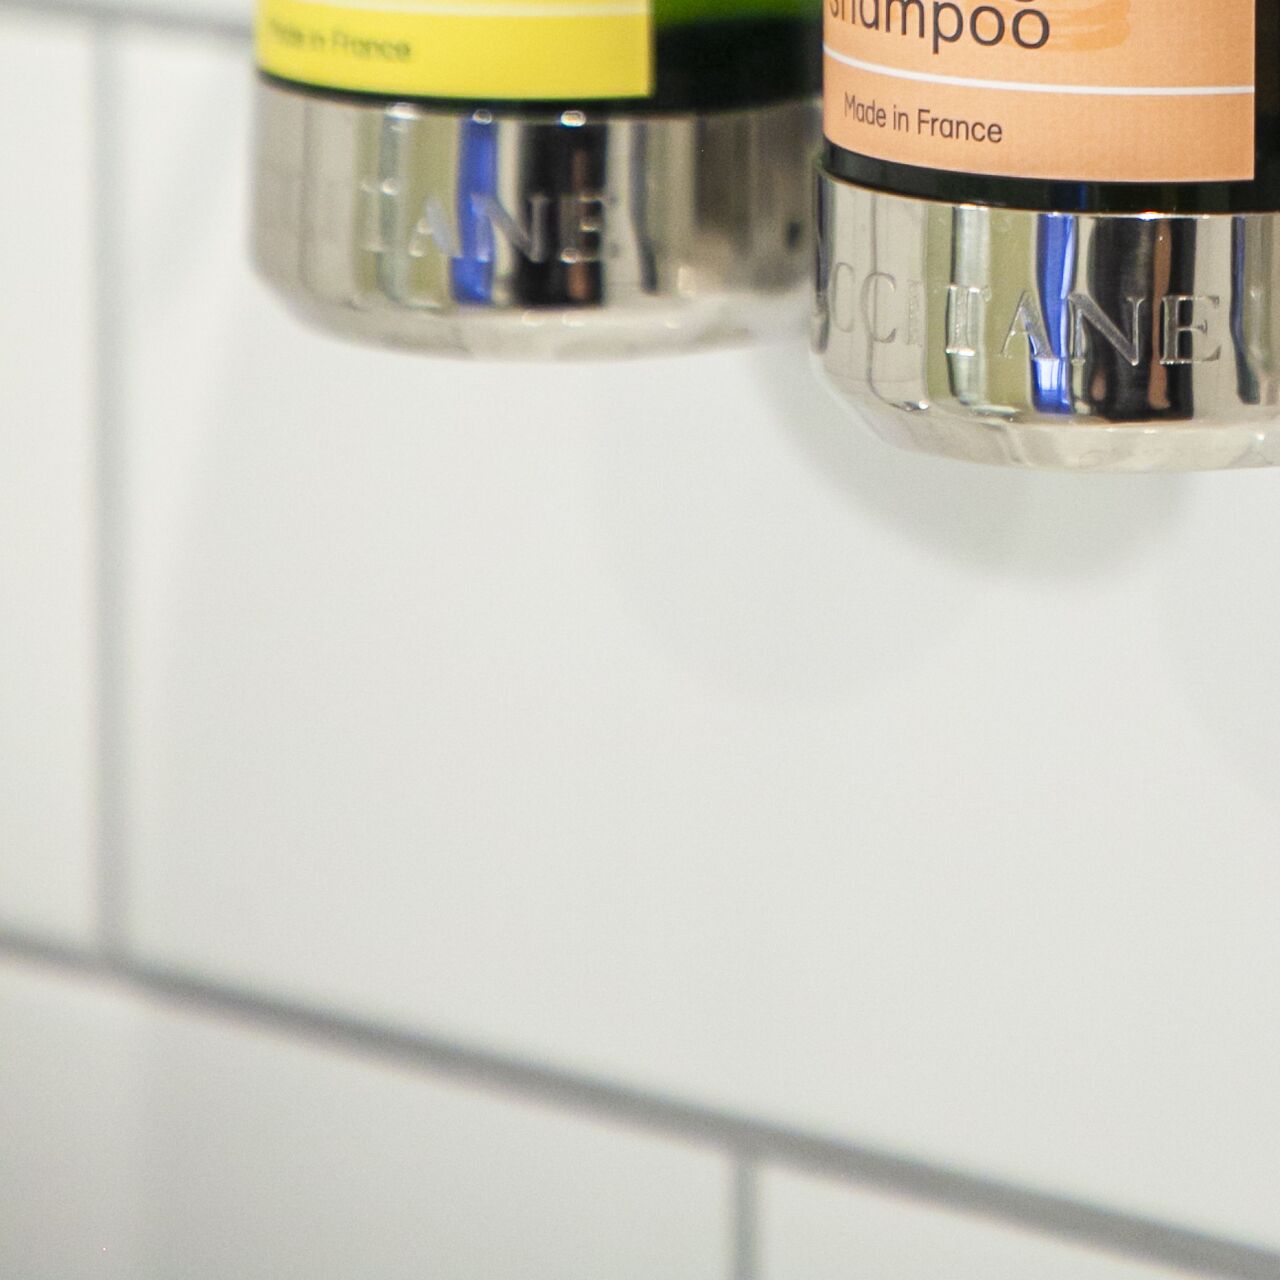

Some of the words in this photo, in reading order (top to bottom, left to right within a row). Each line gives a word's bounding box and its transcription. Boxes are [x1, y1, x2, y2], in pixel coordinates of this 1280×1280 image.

[844, 92, 886, 128] Made
[893, 105, 909, 132] in
[917, 109, 1002, 143] France
